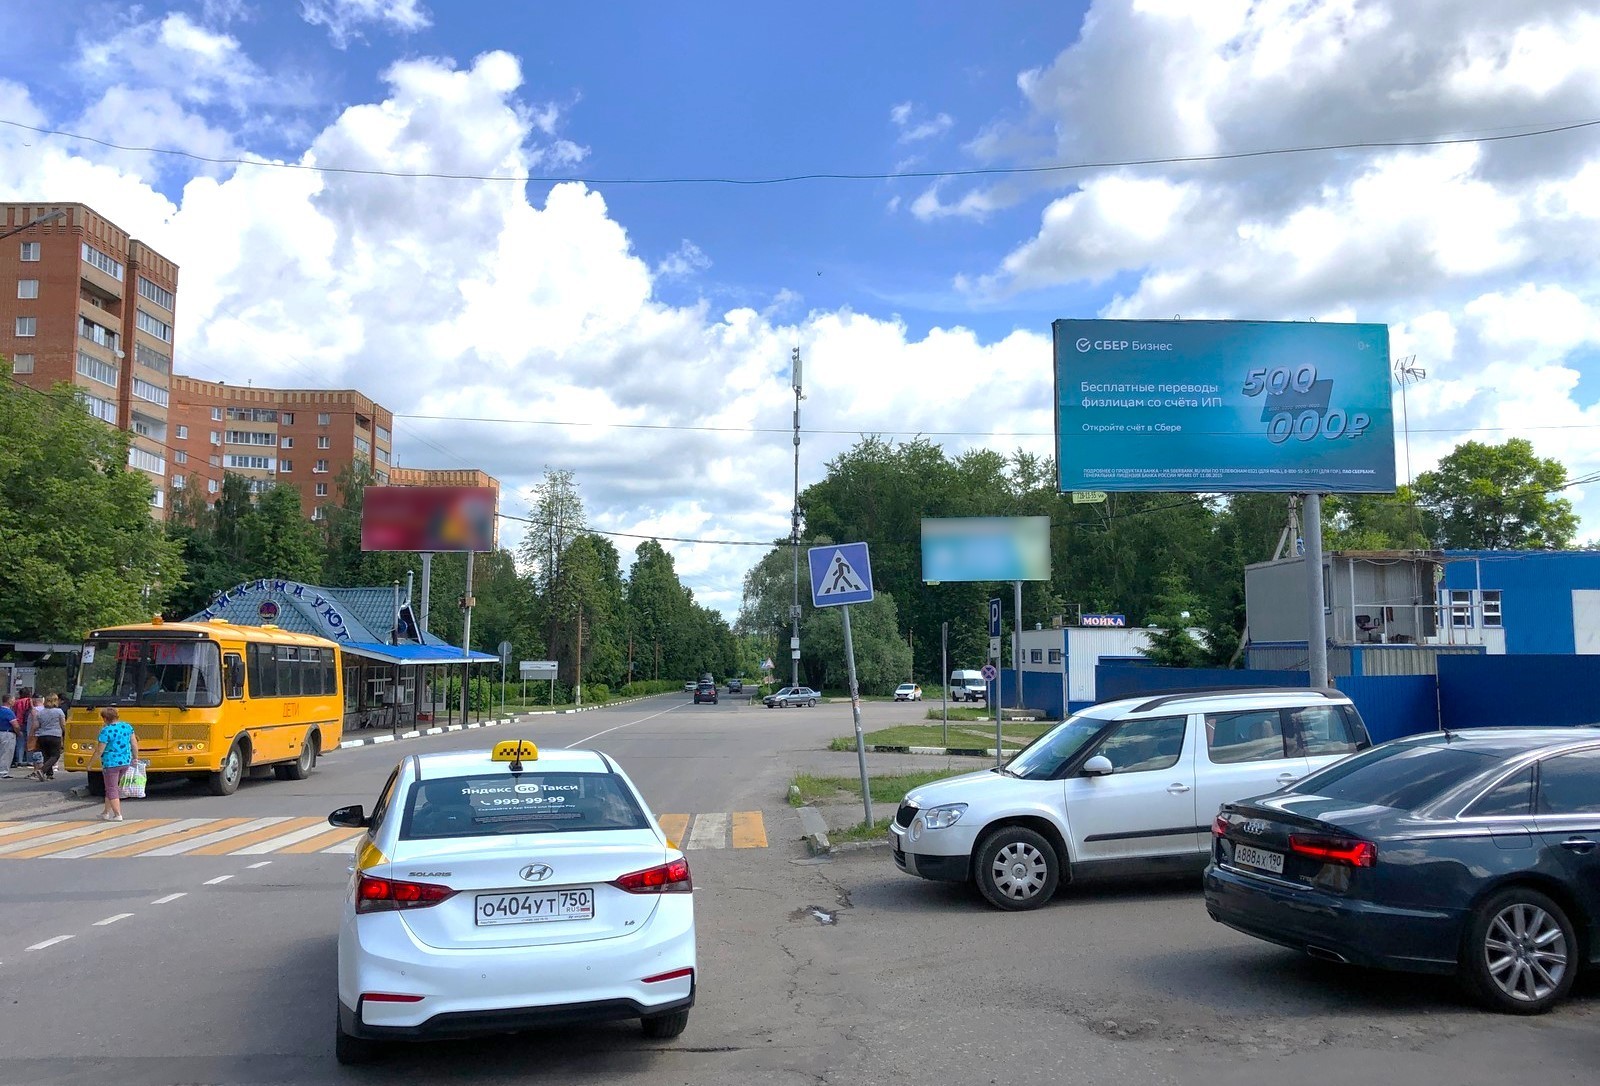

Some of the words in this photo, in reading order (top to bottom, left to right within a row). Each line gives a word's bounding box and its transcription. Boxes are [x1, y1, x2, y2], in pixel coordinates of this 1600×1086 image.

[1094, 340, 1129, 351] СБЕР
[1131, 341, 1173, 351] Бизнес
[1241, 363, 1318, 398] 500
[1081, 382, 1155, 393] Бесплатные
[1158, 384, 1218, 394] переводы
[1081, 397, 1144, 408] физлицам
[1147, 400, 1162, 408] со
[1164, 397, 1198, 408] счёта
[1201, 398, 1222, 408] ИП
[1082, 423, 1125, 433] Откройте
[1126, 423, 1145, 432] счёт
[1154, 423, 1182, 433] Сбере
[1083, 615, 1124, 626] МОЙКА
[282, 702, 300, 718] ДЕТИ
[461, 786, 512, 795] Яндекс
[493, 796, 565, 805] 999-99-99
[1268, 853, 1281, 867] 190
[560, 892, 587, 907] 750
